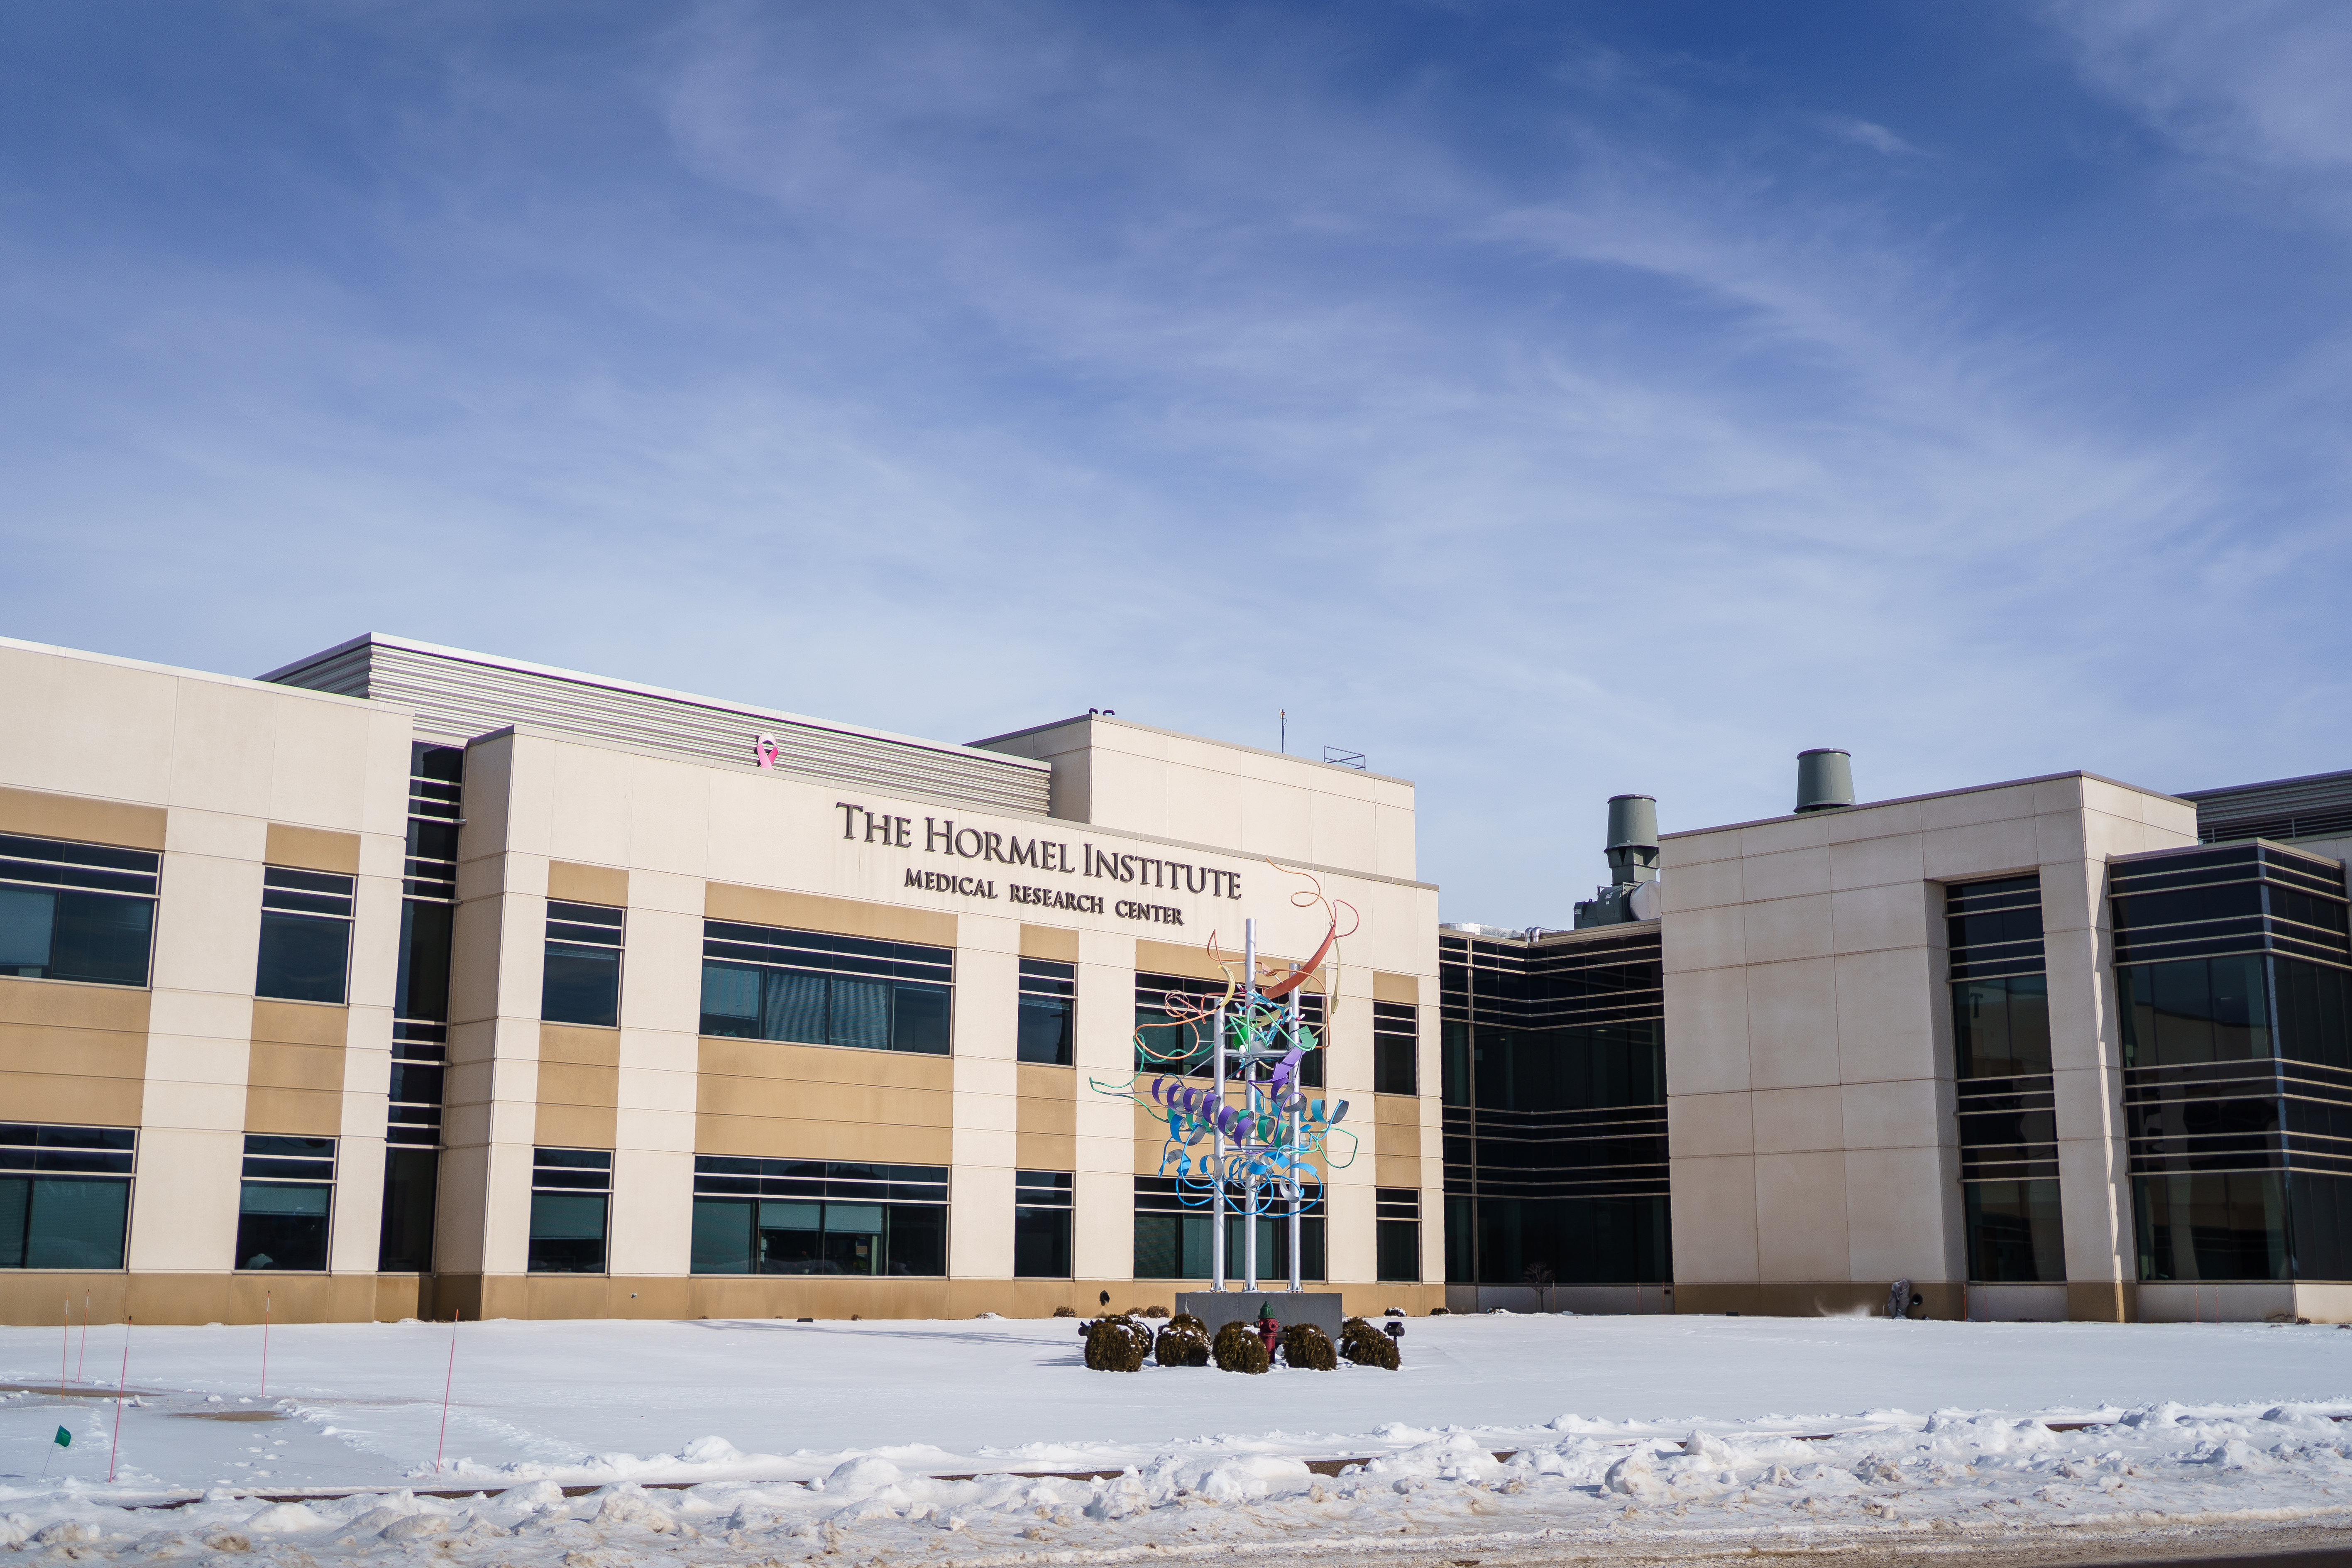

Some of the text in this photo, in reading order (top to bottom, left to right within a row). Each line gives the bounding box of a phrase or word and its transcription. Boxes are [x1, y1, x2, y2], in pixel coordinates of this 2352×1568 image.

[835, 802, 1242, 900] THE HORMEL INSTITUTE
[904, 868, 1185, 926] MEDICAL RESEARCH CENTER
